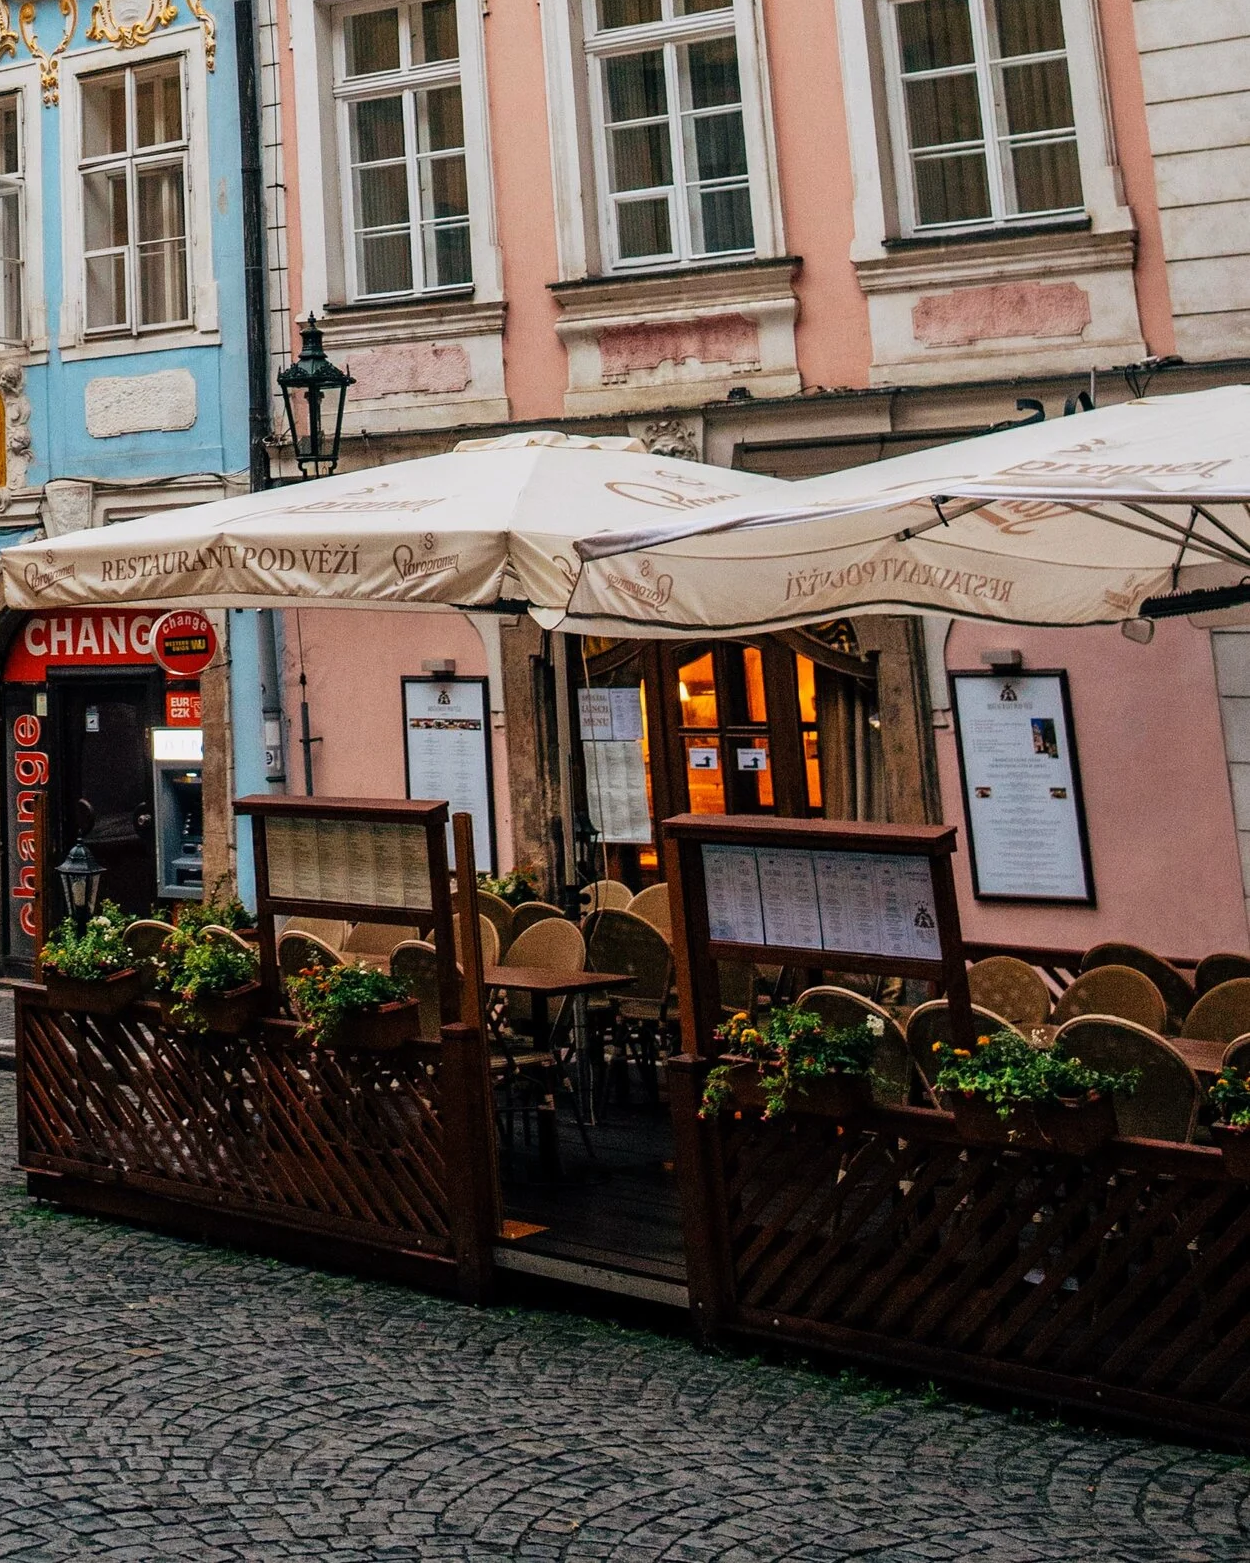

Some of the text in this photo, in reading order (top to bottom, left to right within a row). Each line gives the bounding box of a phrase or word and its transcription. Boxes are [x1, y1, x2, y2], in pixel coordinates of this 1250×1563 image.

[101, 543, 360, 583] RESTAURANT POD VĚŽÍ
[393, 544, 460, 586] Staropramen
[162, 614, 207, 634] change
[170, 697, 190, 707] EUR
[170, 708, 190, 718] CZK
[12, 713, 49, 937] change
